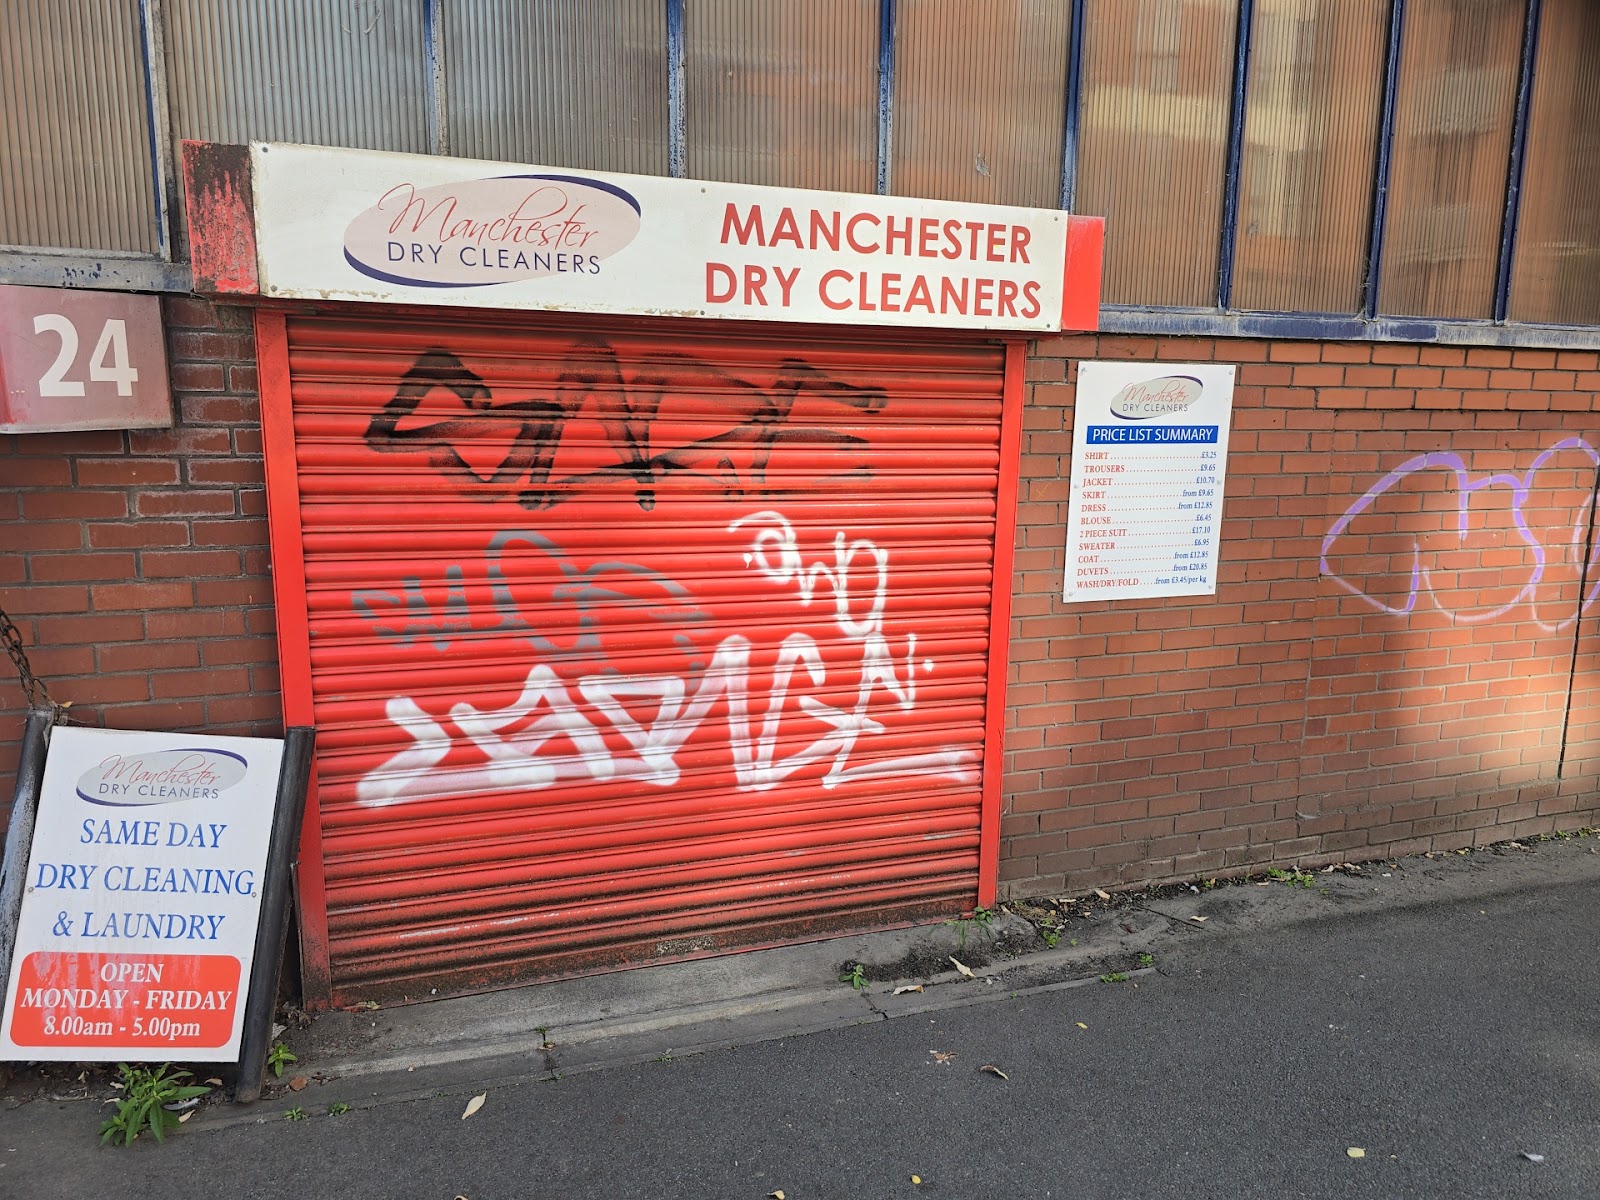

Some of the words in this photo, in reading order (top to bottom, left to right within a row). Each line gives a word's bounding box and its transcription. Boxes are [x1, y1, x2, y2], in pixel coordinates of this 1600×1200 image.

[378, 183, 601, 250] Manchester
[720, 203, 1031, 264] MANCHESTER
[388, 241, 443, 264] DRY
[460, 247, 600, 275] CLEANERS
[706, 262, 801, 306] DRY
[818, 269, 1041, 319] CLEANERS
[33, 314, 138, 397] 24
[1123, 380, 1189, 403] Manchester
[1093, 429, 1125, 441] PRICE
[1129, 429, 1153, 441] LIST
[1155, 428, 1213, 441] SUMMARY
[1082, 478, 1113, 487] JACKET
[1081, 504, 1106, 512] DRESS
[1081, 517, 1111, 525] BLOUSE
[1079, 542, 1115, 550] SWEATER
[1077, 568, 1108, 576] DUVETS
[1077, 578, 1139, 589] WASH/DRY/FOLD
[1171, 576, 1198, 584] £3.45/per
[100, 754, 221, 785] Manchester
[99, 783, 130, 795] DRY
[138, 785, 219, 799] CLEANERS
[80, 818, 160, 846] SAME
[166, 822, 227, 848] DAY
[35, 863, 98, 890] DRY
[104, 866, 254, 895] CLEANING
[53, 911, 74, 936] &
[82, 912, 226, 939] LAUNDRY
[101, 962, 164, 983] OPEN
[21, 988, 128, 1008] MONDAY
[145, 990, 232, 1010] FRIDAY
[44, 1016, 112, 1036] 8.00am
[132, 1018, 200, 1040] 5.00pm
